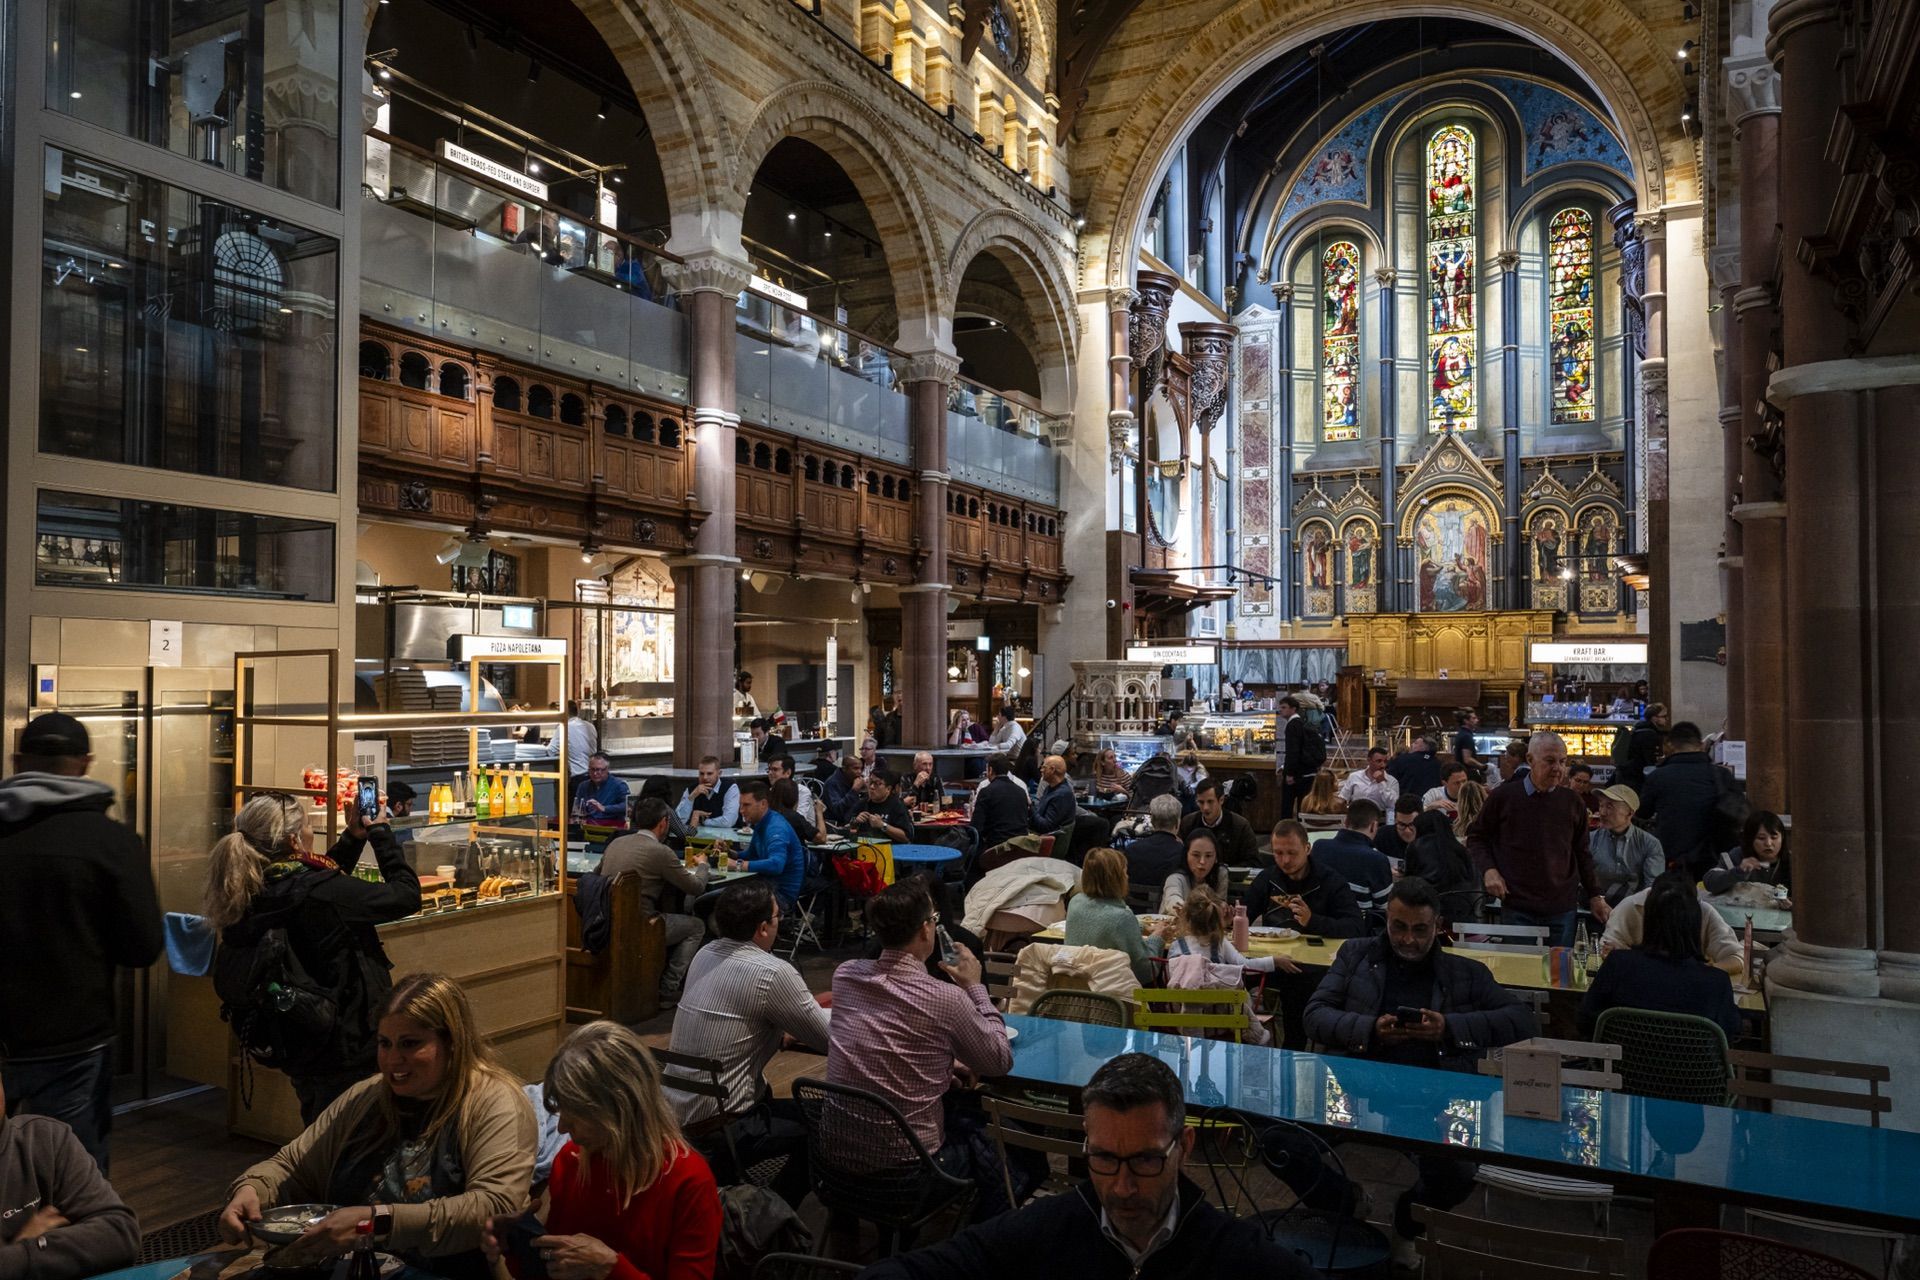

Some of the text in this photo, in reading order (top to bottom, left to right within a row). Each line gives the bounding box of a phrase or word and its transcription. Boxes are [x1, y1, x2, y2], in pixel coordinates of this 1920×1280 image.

[450, 148, 541, 194] BRITISH GRASS-FED STEAK AND BURGER
[162, 639, 170, 651] 2
[491, 642, 542, 654] PIZZA NAPOLETANA
[1573, 648, 1606, 656] KRAFT BAR
